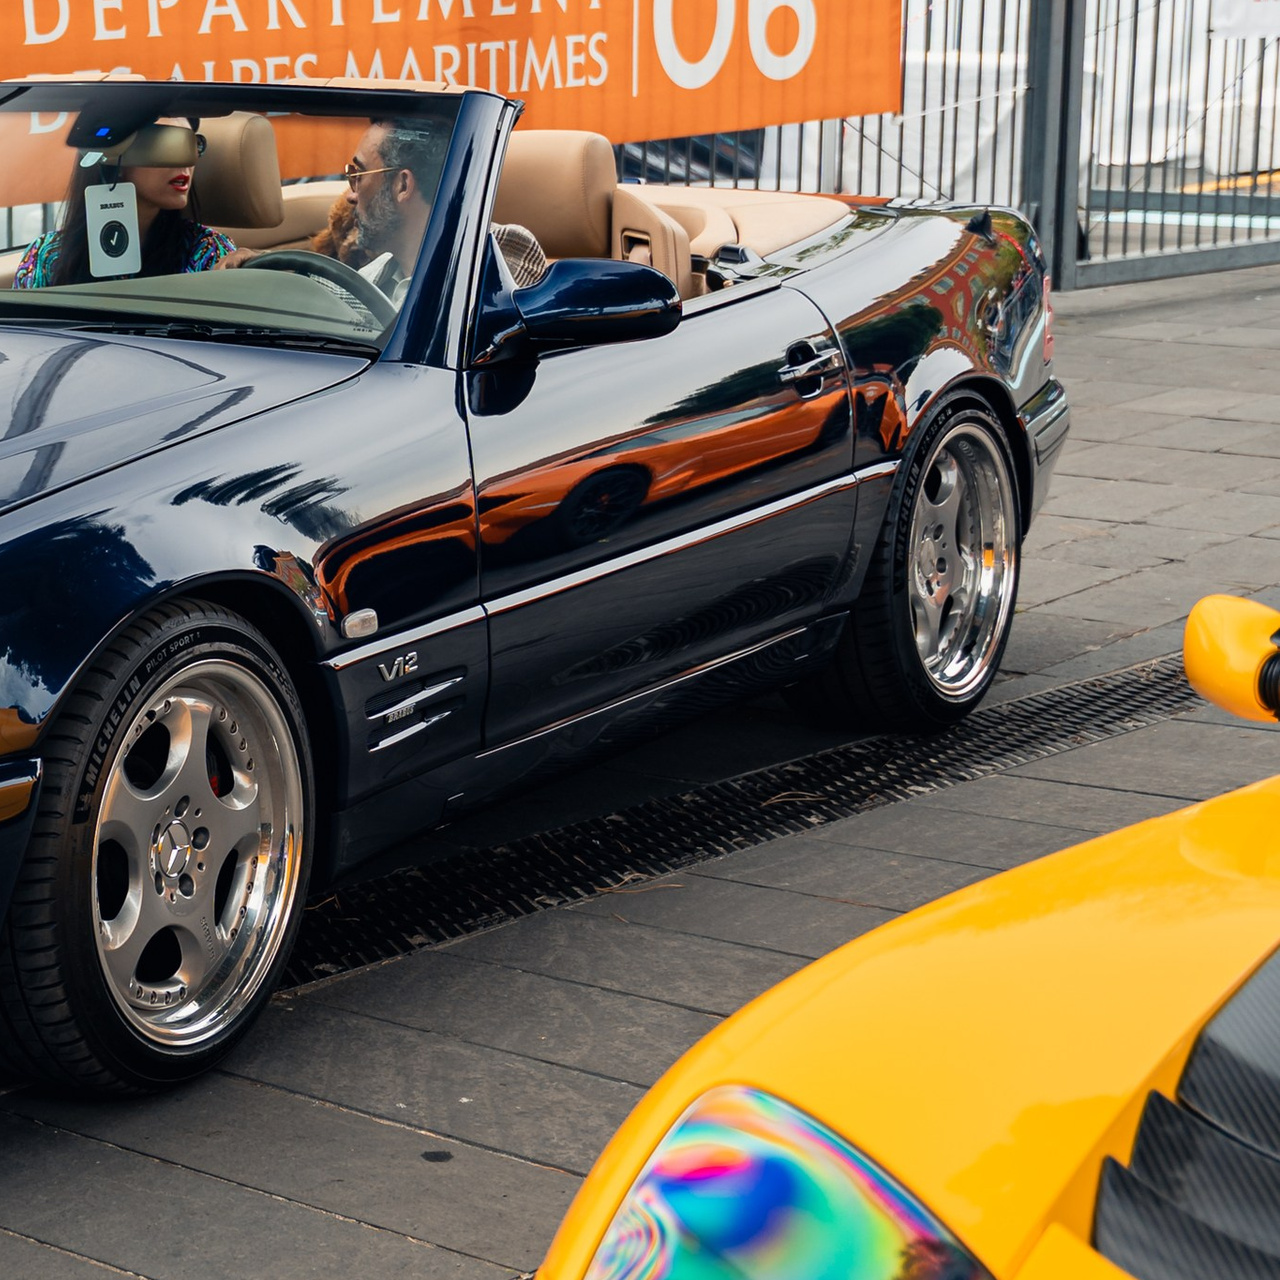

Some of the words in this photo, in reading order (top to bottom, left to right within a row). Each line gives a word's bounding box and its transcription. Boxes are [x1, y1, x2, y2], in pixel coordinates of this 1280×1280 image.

[345, 31, 609, 94] MARITIMES
[896, 463, 920, 561] MICHELIN
[378, 651, 419, 682] V12
[84, 674, 141, 787] MICHELIN
[145, 648, 168, 673] PILOT
[169, 633, 195, 653] SPORT
